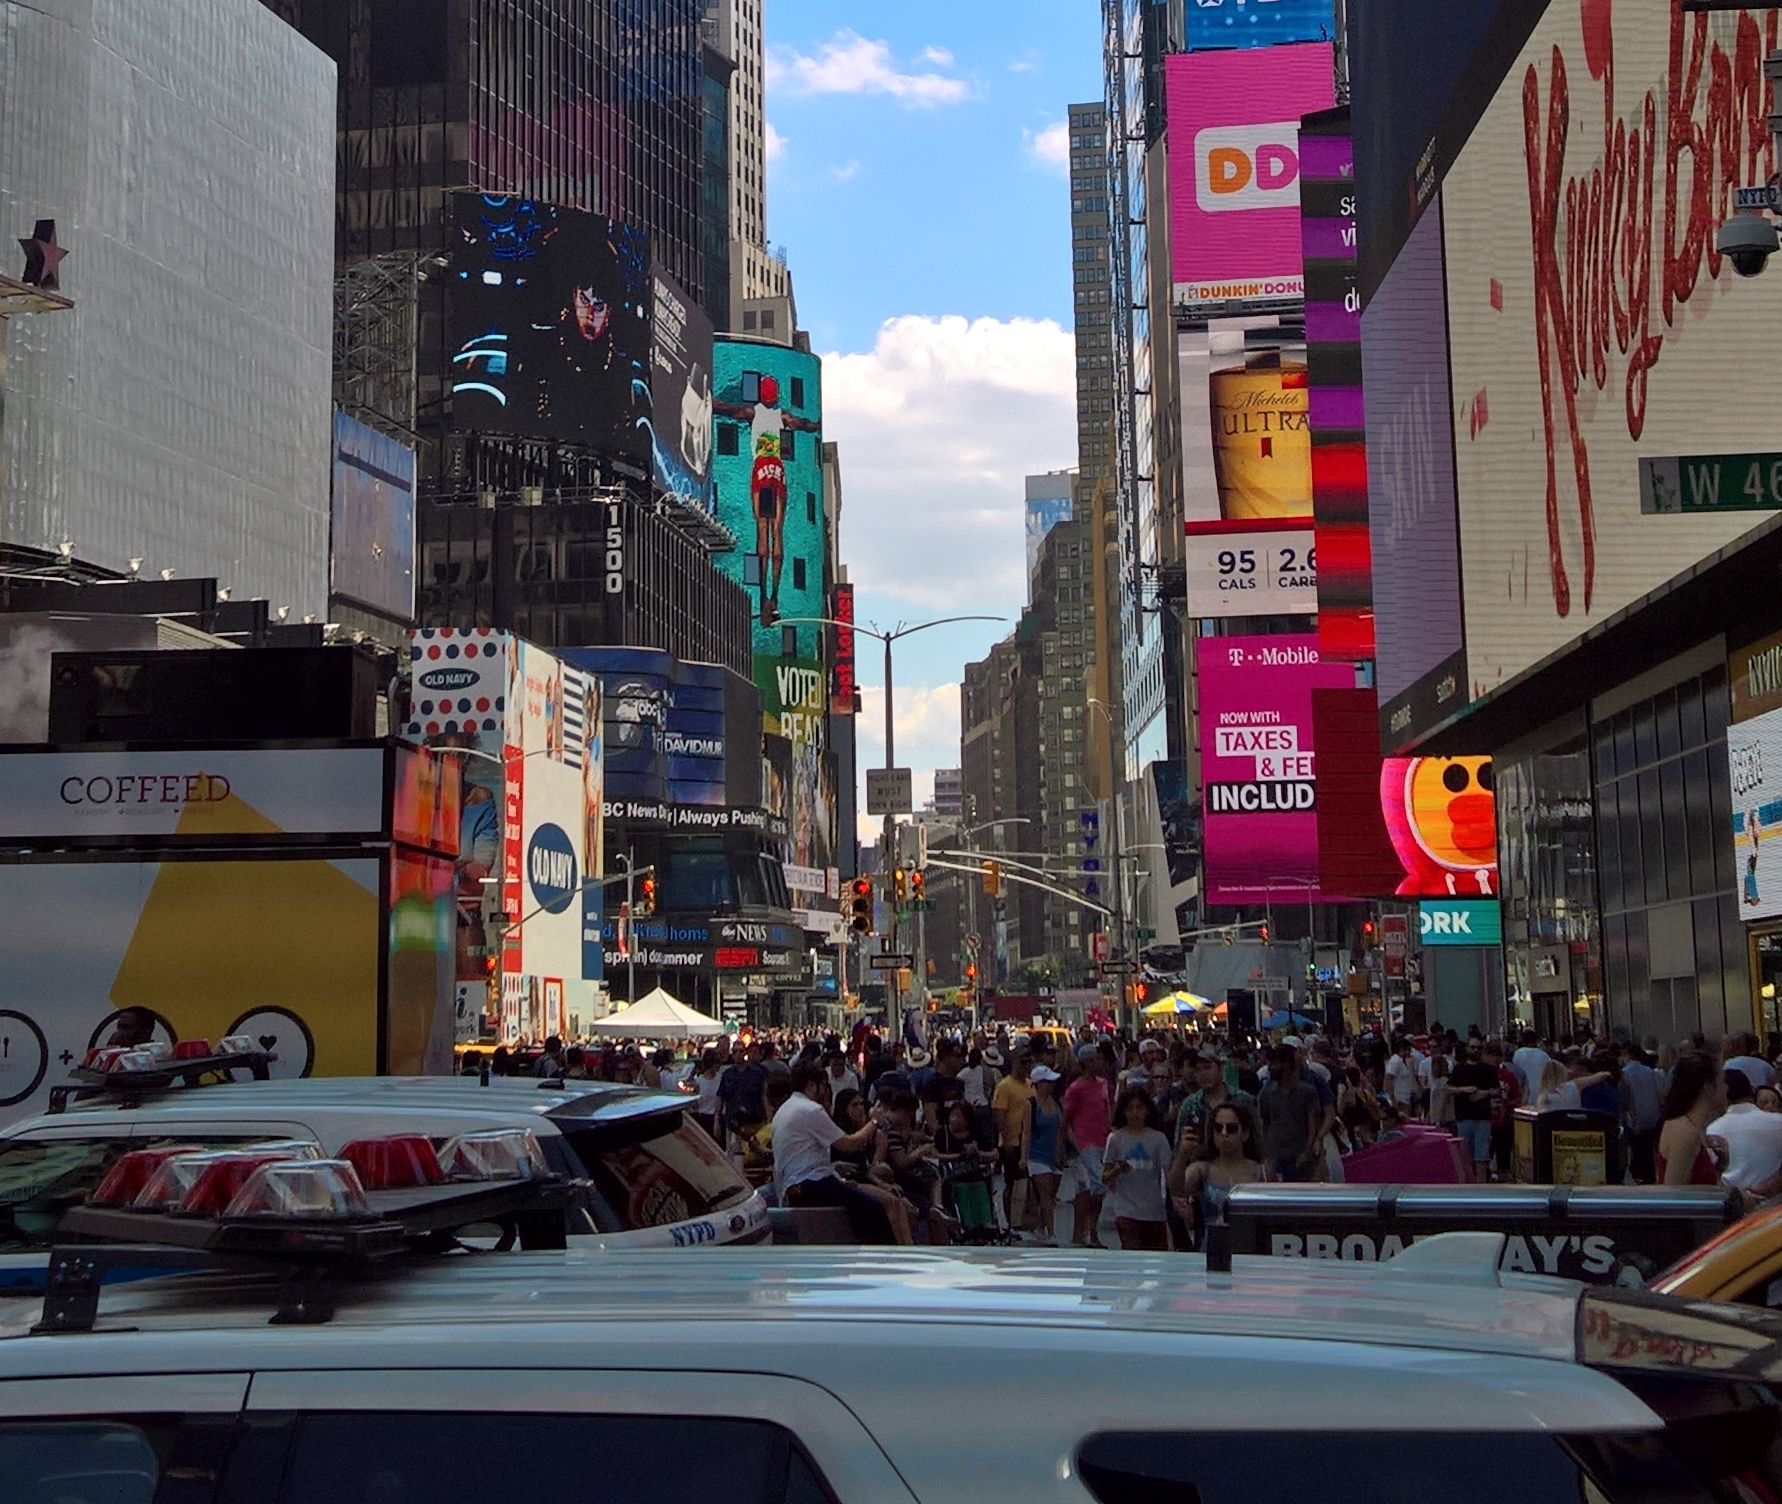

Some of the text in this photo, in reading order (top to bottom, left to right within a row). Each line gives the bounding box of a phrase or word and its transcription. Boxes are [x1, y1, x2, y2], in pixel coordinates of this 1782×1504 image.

[1207, 143, 1299, 195] DD
[1199, 280, 1305, 299] DUNKIN' DONU
[1521, 43, 1664, 619] Kinky
[1222, 410, 1311, 436] ULTRA
[1687, 464, 1721, 505] W
[604, 498, 623, 593] 1500
[1217, 549, 1257, 575] 95
[1218, 575, 1318, 590] CALS CARB
[424, 672, 475, 685] OLD NAVY
[1220, 710, 1280, 724] NOW WITH
[1221, 728, 1293, 752] TAXES
[1260, 756, 1315, 777] & FE
[59, 773, 231, 805] COFFEED
[1212, 784, 1315, 811] INCLUD
[602, 801, 624, 817] BC
[678, 808, 729, 828] Always
[731, 809, 767, 828] Pushing
[532, 845, 574, 890] OLD NAVY
[670, 926, 709, 941] home
[736, 924, 767, 942] NEWS
[669, 1221, 716, 1247] NYPD
[1271, 1233, 1617, 1276] BROAAY'S
